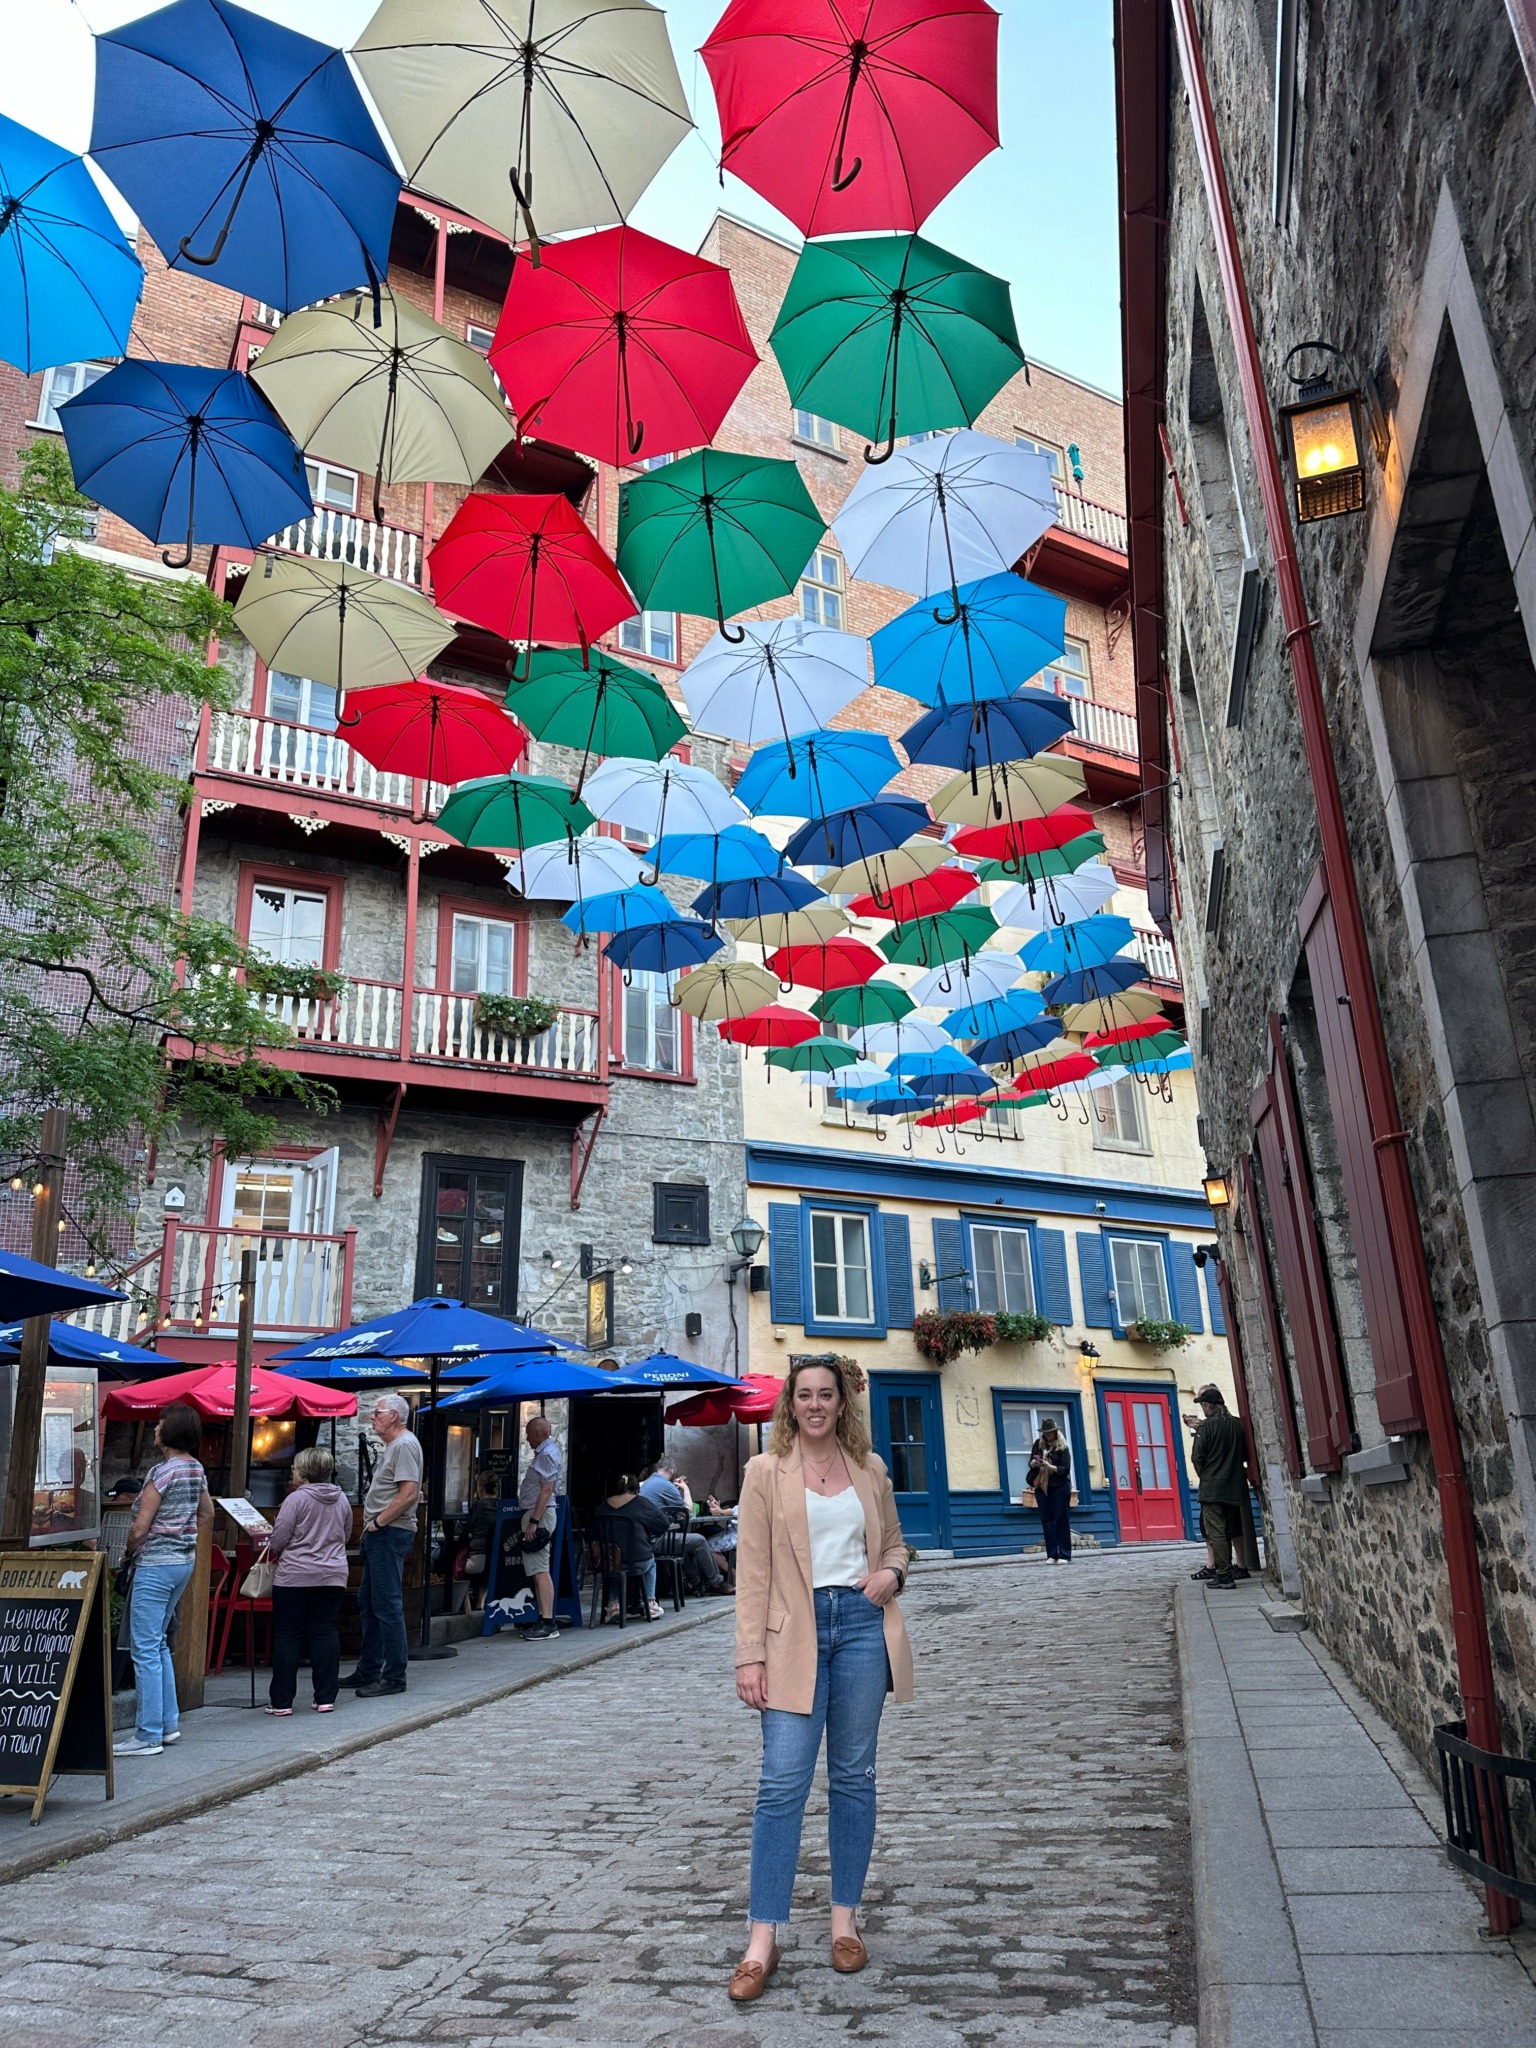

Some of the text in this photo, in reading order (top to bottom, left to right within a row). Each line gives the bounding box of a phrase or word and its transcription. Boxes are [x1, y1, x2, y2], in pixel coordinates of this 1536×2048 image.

[643, 1371, 690, 1379] PERONI
[1, 1569, 57, 1588] BORÉALE
[24, 1630, 32, 1653] à
[18, 1662, 60, 1685] VILLE
